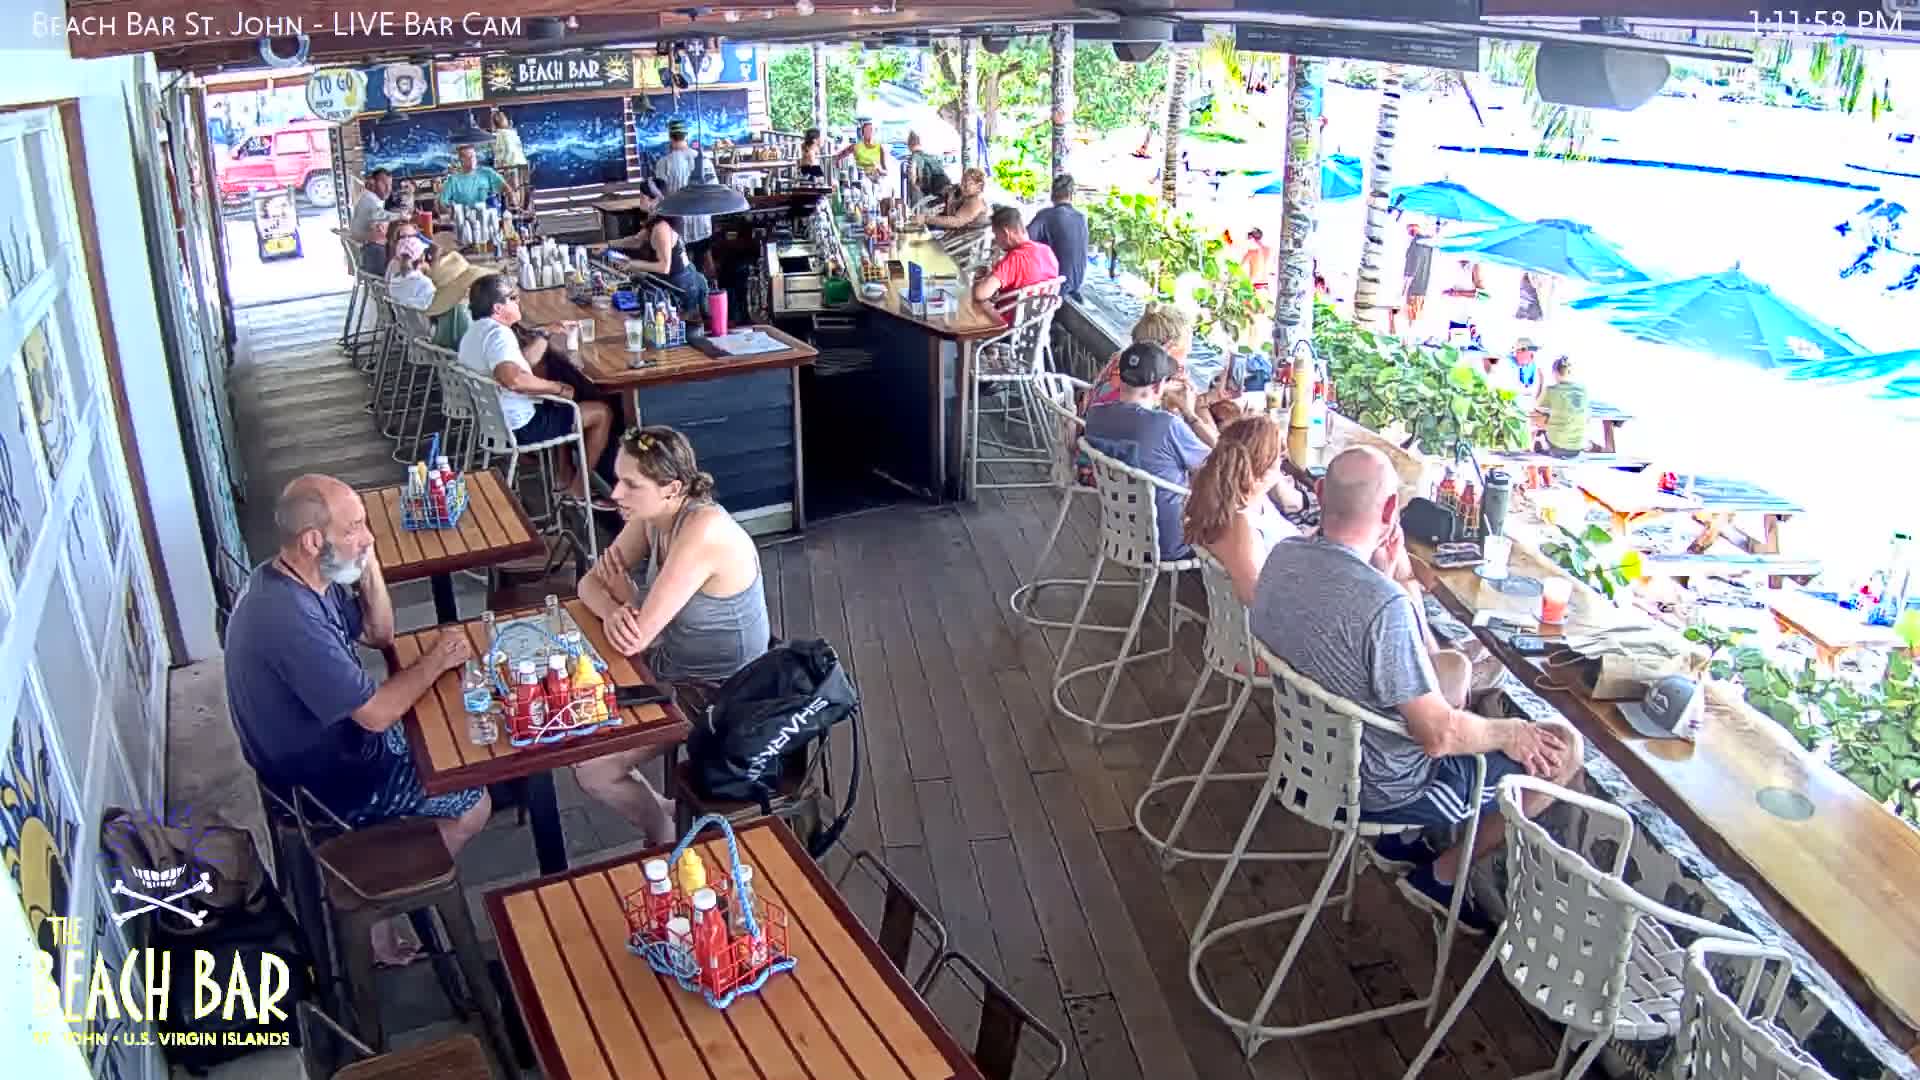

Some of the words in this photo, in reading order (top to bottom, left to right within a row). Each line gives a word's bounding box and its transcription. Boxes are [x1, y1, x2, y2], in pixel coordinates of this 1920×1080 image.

[519, 60, 563, 82] BEACH
[568, 60, 600, 79] BAR
[314, 75, 331, 97] TO
[336, 71, 353, 92] GO
